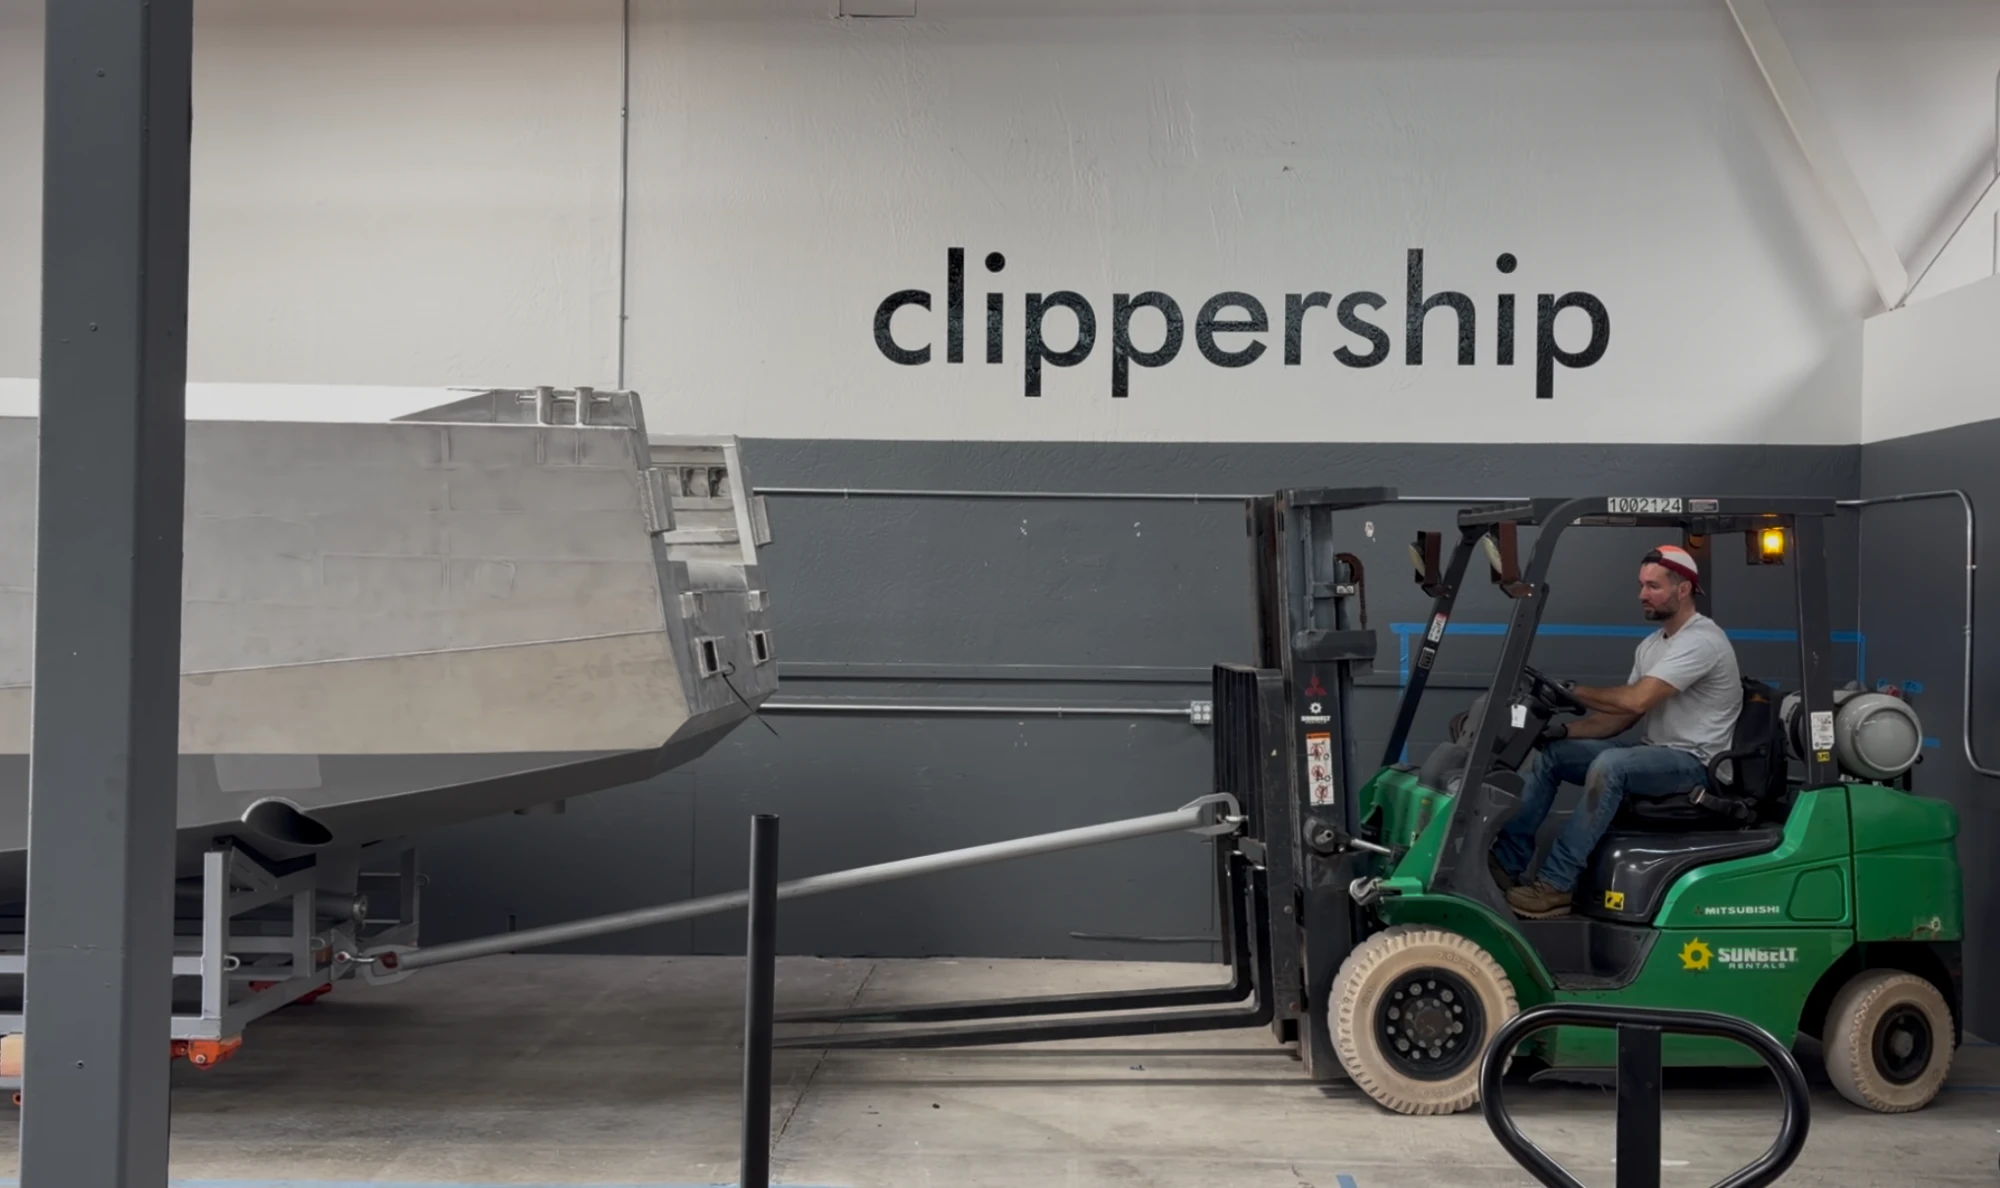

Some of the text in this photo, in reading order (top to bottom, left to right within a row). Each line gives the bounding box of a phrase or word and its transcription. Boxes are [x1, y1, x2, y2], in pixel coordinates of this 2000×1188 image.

[873, 247, 1610, 399] clippership
[1609, 498, 1681, 512] 1002124
[1705, 905, 1780, 915] MITSUBISHI
[1718, 947, 1798, 962] SUNBELT
